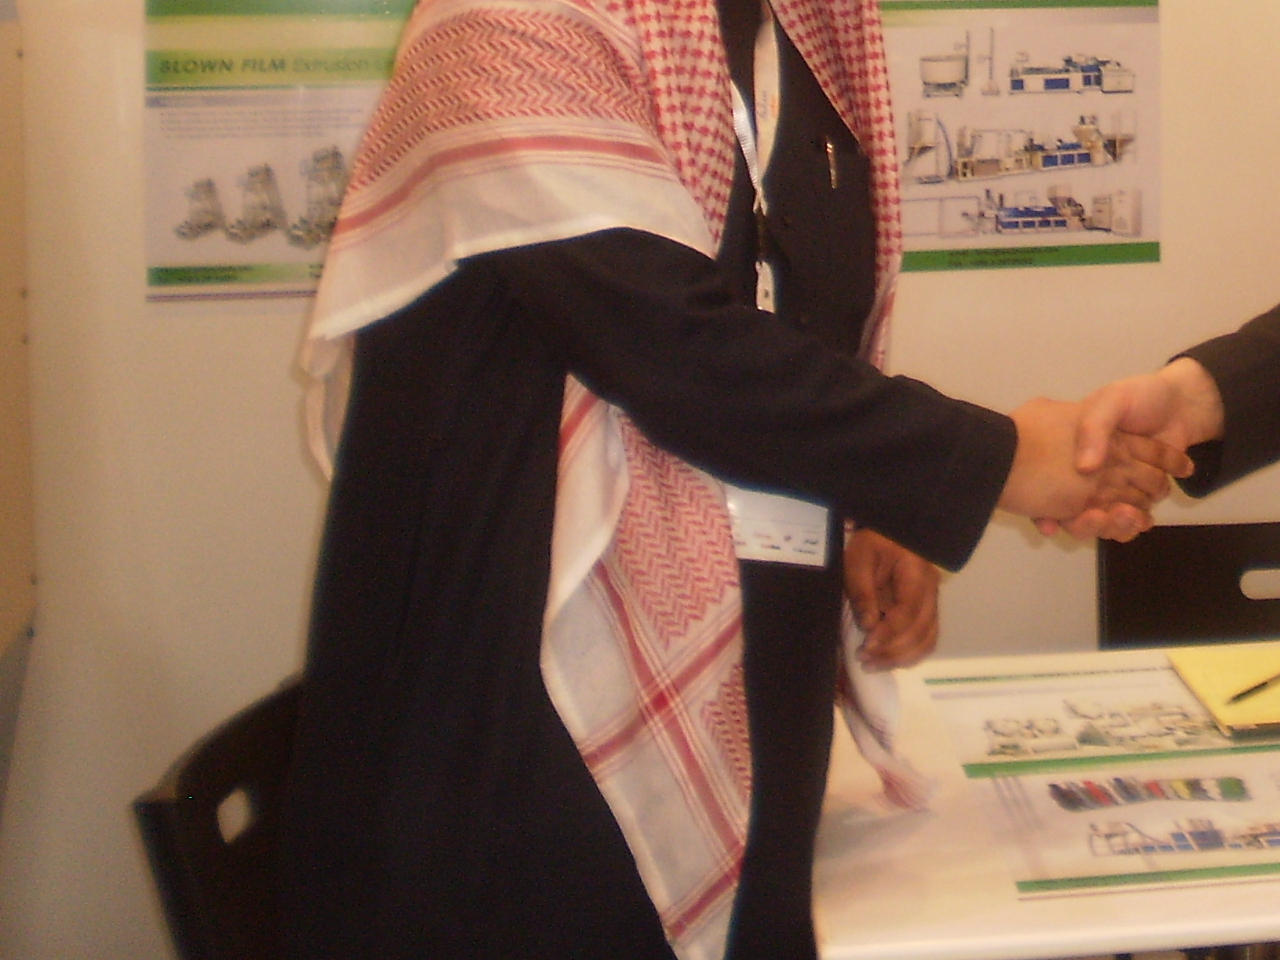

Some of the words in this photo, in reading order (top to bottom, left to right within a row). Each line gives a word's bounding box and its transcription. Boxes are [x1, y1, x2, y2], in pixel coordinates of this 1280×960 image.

[159, 58, 234, 74] BLOWN
[241, 57, 287, 73] FILM
[292, 58, 369, 73] Extrusion
